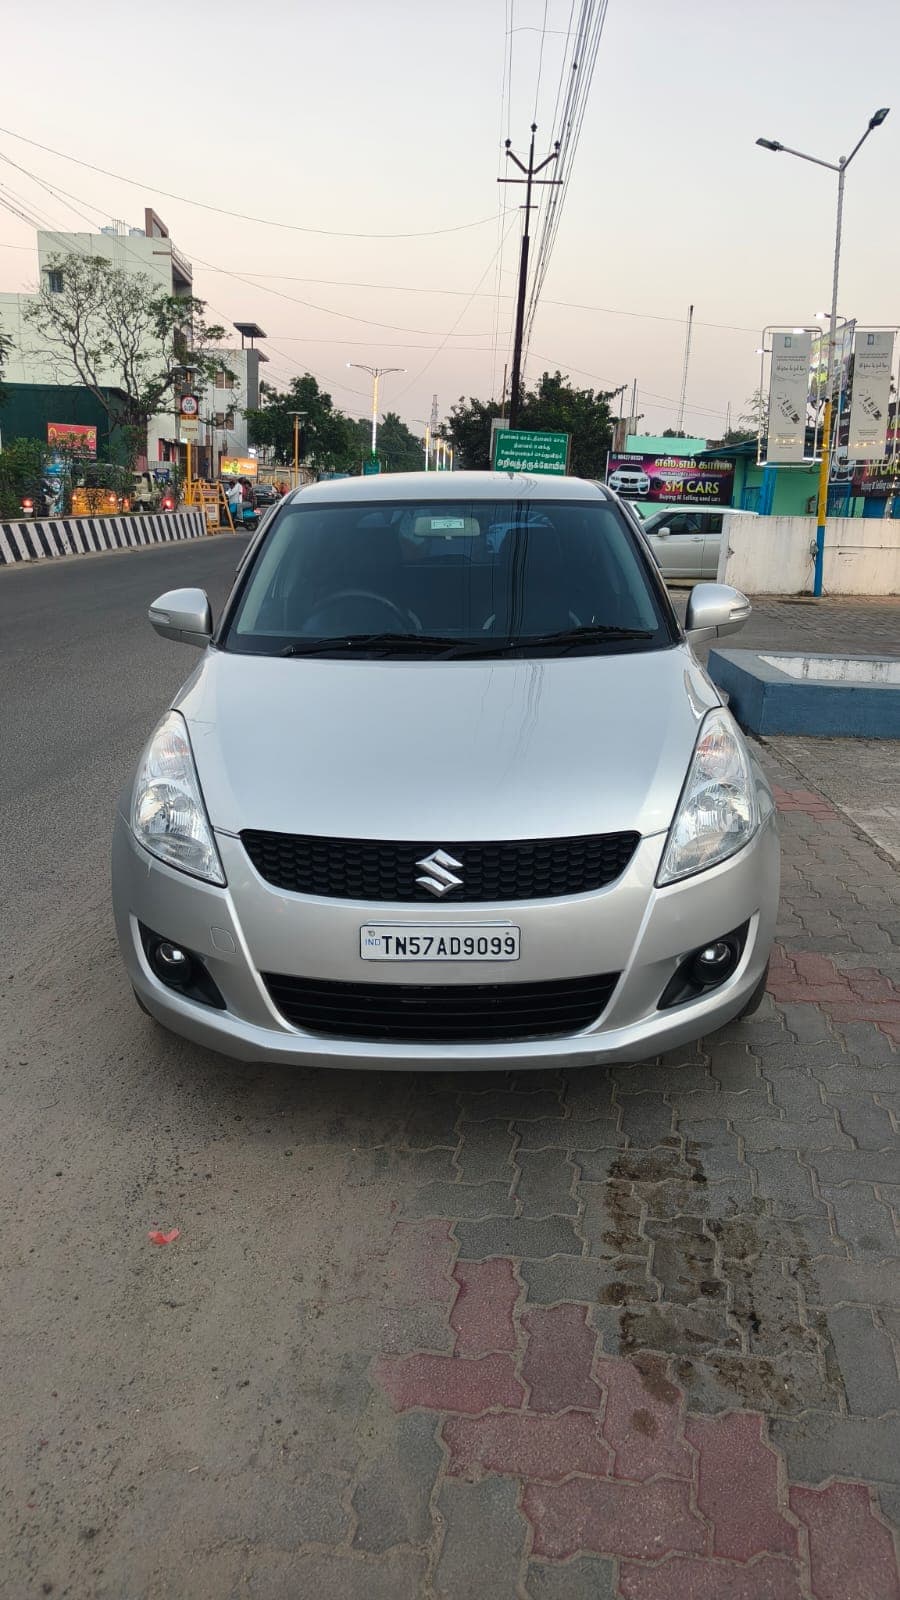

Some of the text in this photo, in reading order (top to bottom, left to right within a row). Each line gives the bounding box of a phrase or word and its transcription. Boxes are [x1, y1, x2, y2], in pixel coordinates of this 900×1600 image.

[698, 460, 732, 471] கார்ஸ்
[664, 480, 720, 494] SM CARS
[365, 936, 516, 955] IND TN57AD9099
